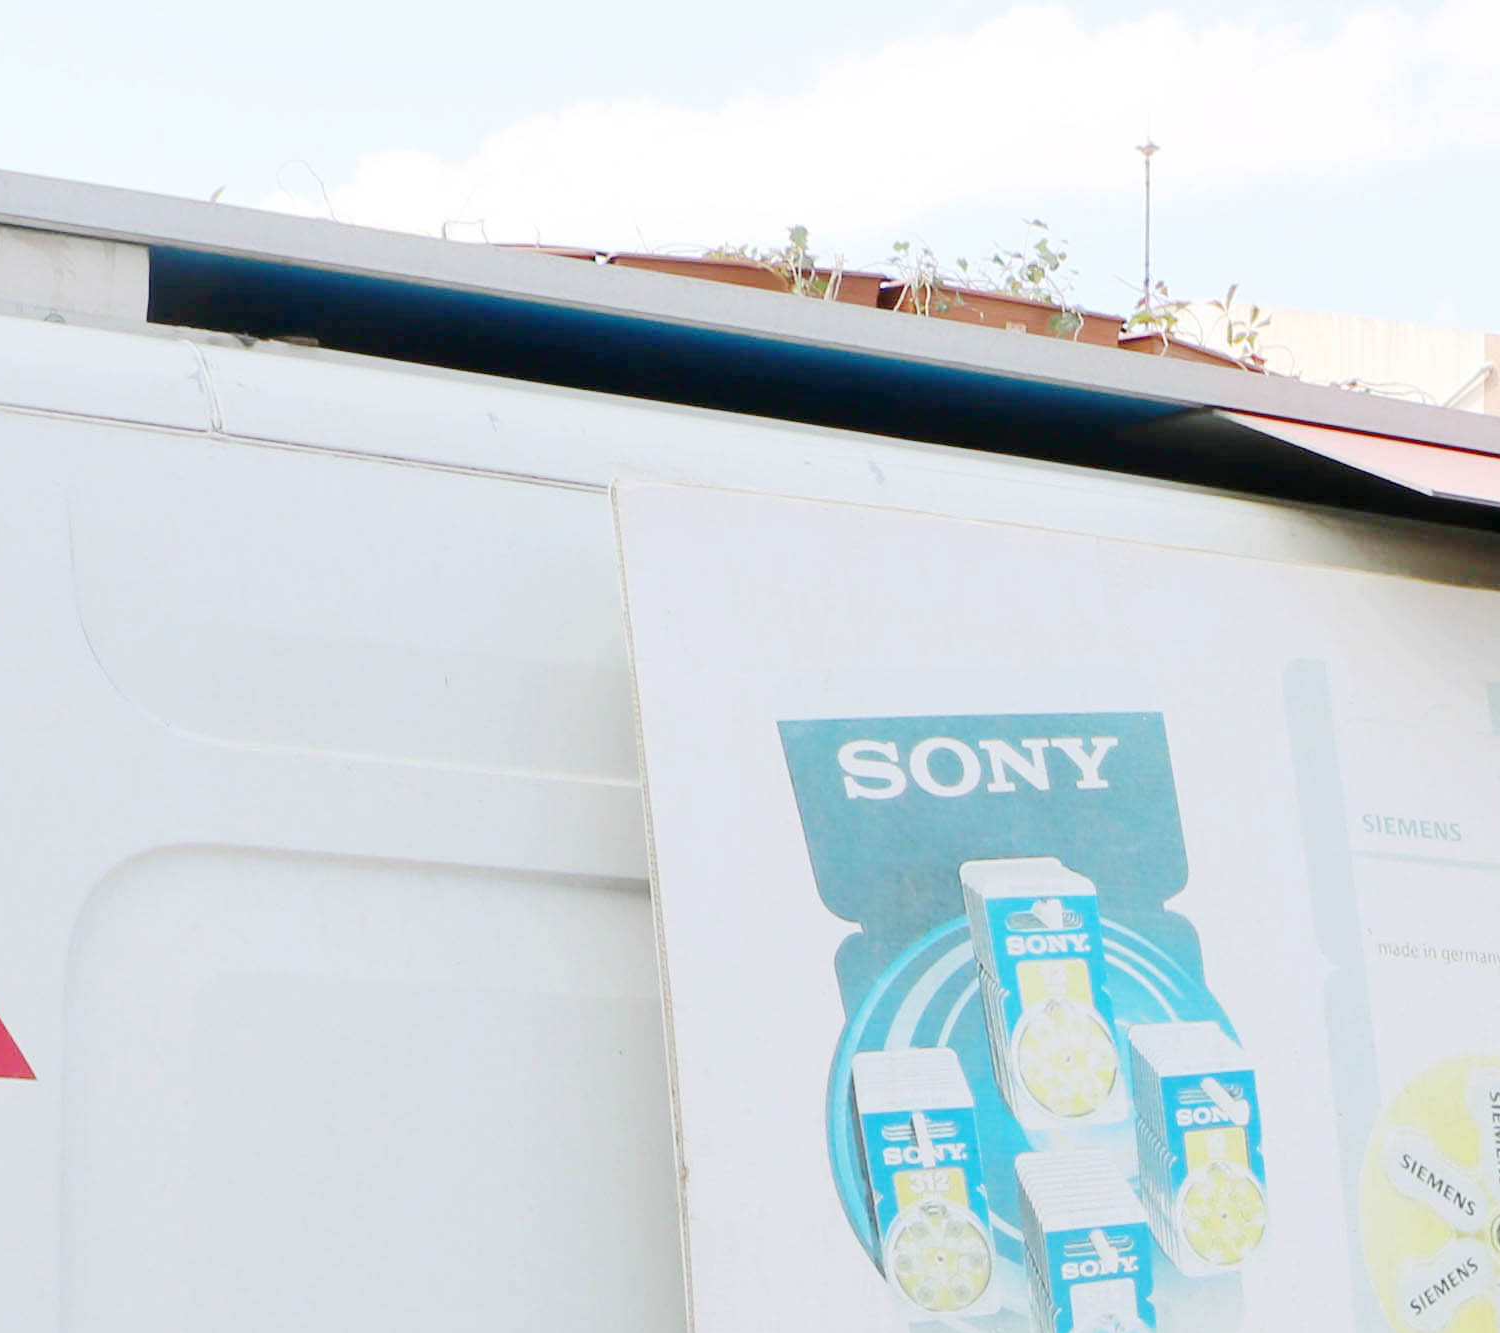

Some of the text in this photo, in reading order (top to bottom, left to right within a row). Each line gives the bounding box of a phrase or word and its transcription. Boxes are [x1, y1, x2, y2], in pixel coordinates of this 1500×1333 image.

[837, 737, 1118, 799] SONY
[1363, 814, 1462, 841] SIEMENS
[1006, 934, 1090, 956] SONY
[1400, 1154, 1476, 1216] SIEMENS
[1410, 1258, 1478, 1316] SIEMENS
